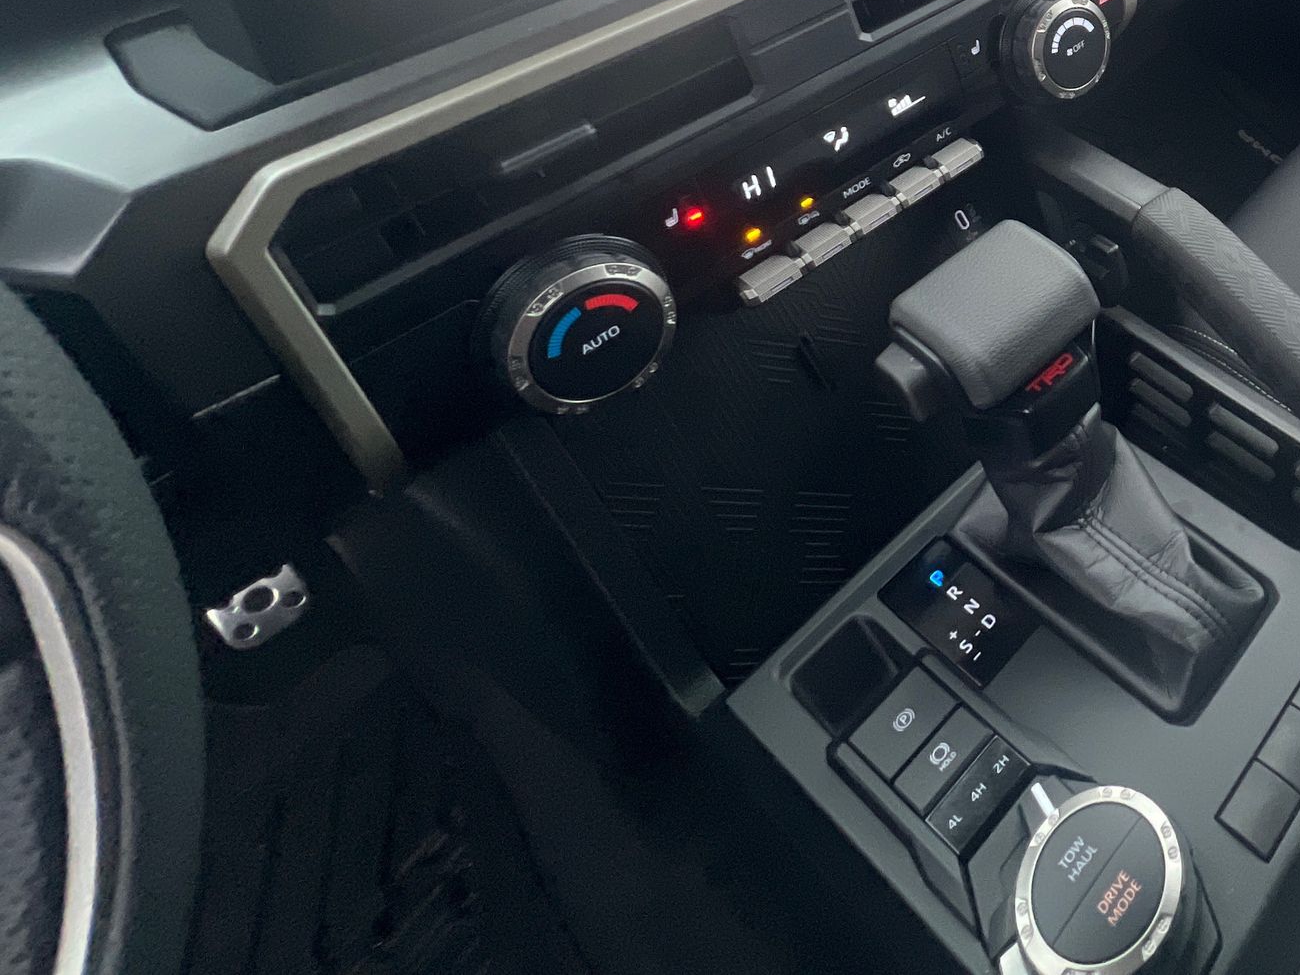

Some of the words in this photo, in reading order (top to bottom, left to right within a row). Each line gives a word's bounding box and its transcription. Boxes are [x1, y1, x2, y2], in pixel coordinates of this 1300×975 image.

[1072, 39, 1086, 53] OFF
[935, 126, 952, 143] A/C
[741, 165, 777, 200] HI
[843, 175, 872, 200] MODE
[581, 324, 621, 356] AUTO
[1024, 352, 1074, 392] TRD
[929, 569, 945, 587] P
[946, 585, 964, 601] R
[963, 597, 981, 615] N
[980, 613, 996, 630] D
[959, 638, 974, 654] S
[938, 750, 957, 772] HOLD
[992, 754, 1010, 774] 2H
[970, 782, 988, 802] 4H
[948, 814, 964, 830] 4L
[1057, 835, 1086, 870] TOW
[1067, 845, 1099, 883] HAUL
[1096, 869, 1131, 915] DRIVE
[1107, 879, 1143, 927] MODE
